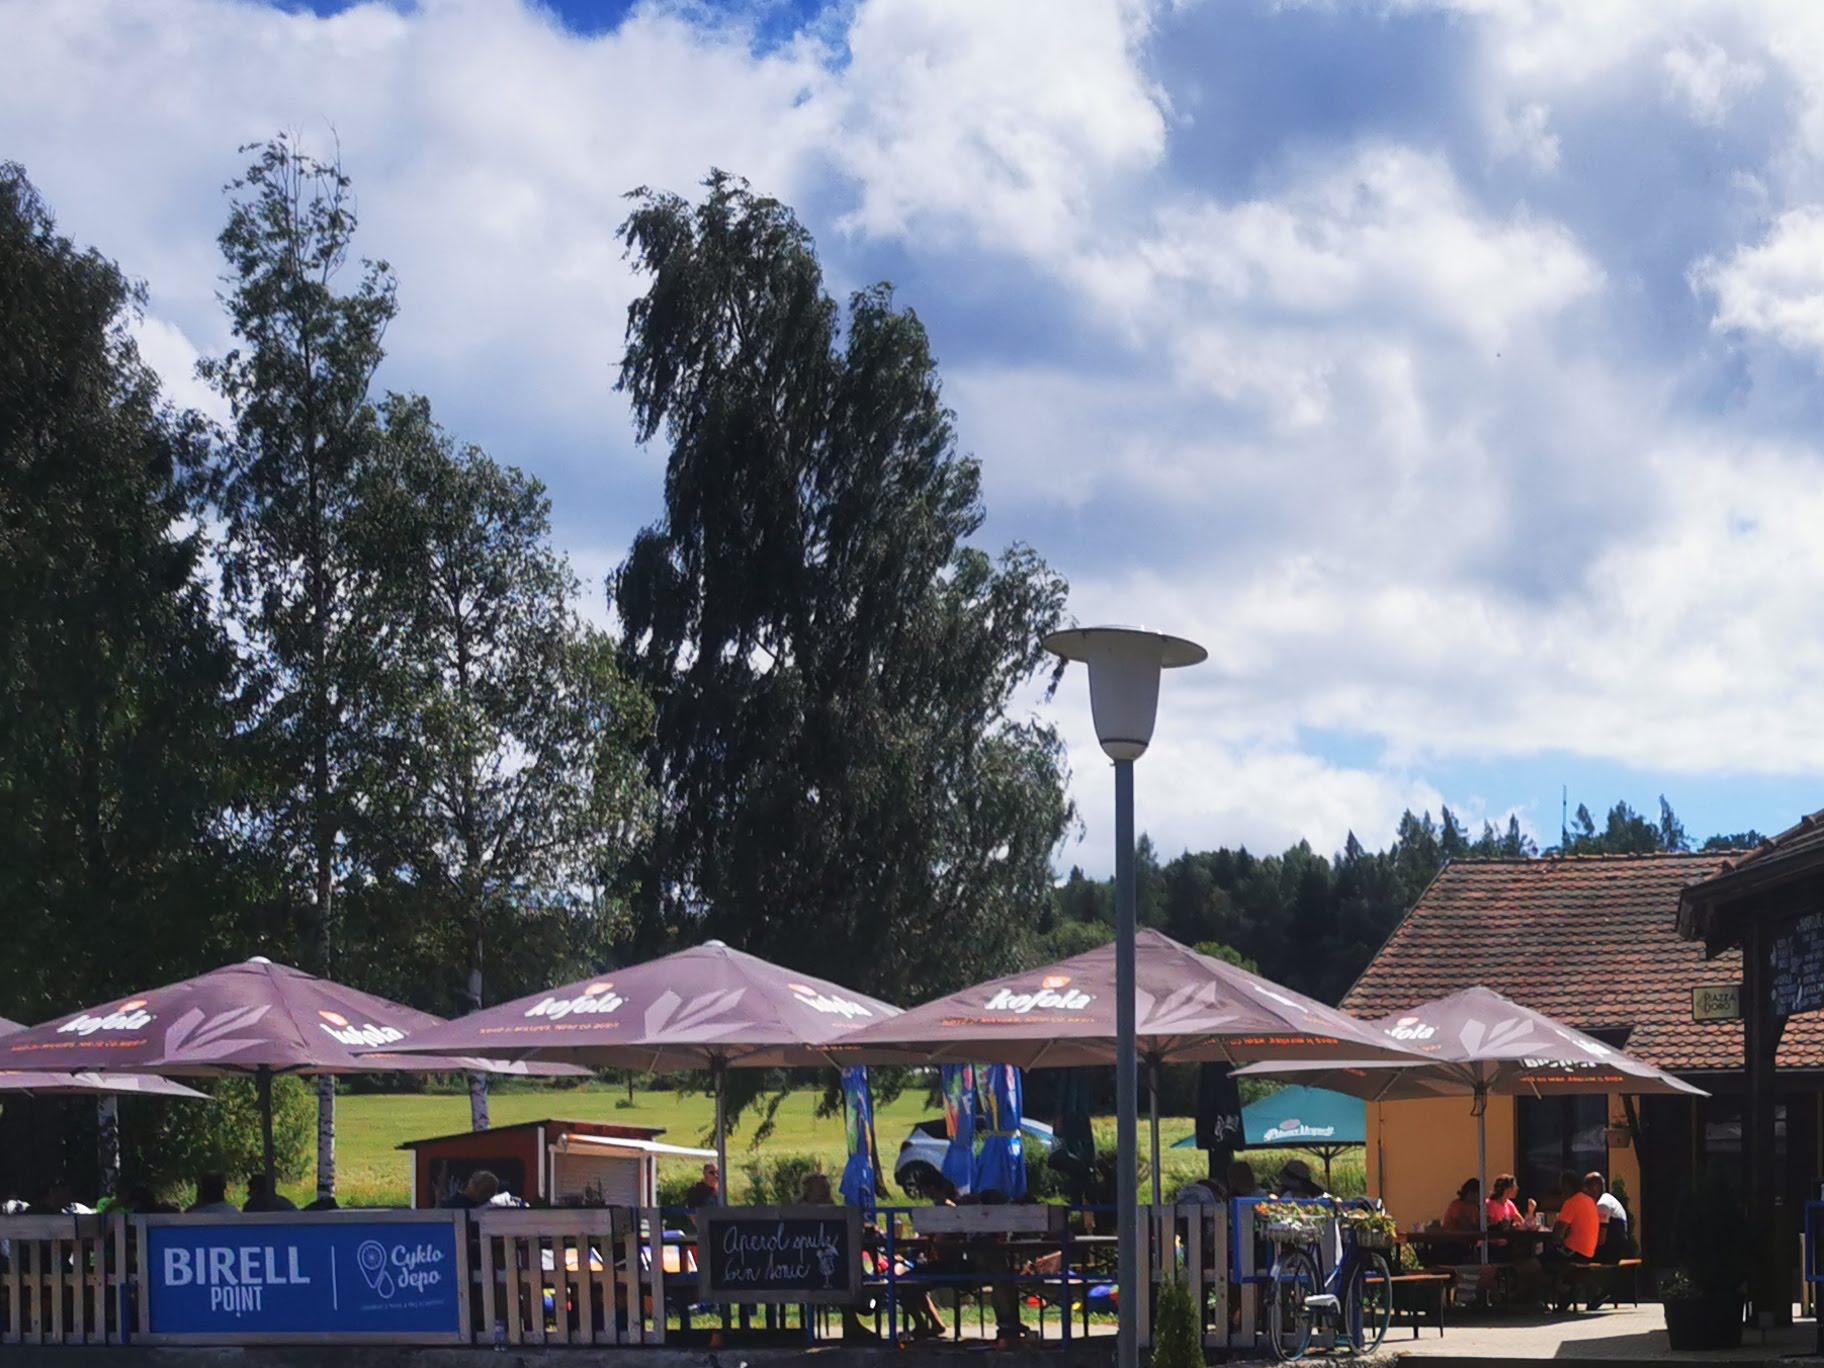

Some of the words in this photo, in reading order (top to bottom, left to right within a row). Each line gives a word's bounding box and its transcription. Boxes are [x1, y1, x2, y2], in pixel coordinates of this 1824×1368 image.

[164, 1246, 311, 1286] BIRELL
[391, 1244, 444, 1270] Cyklo
[398, 1266, 442, 1293] depo
[211, 1285, 263, 1318] POINT
